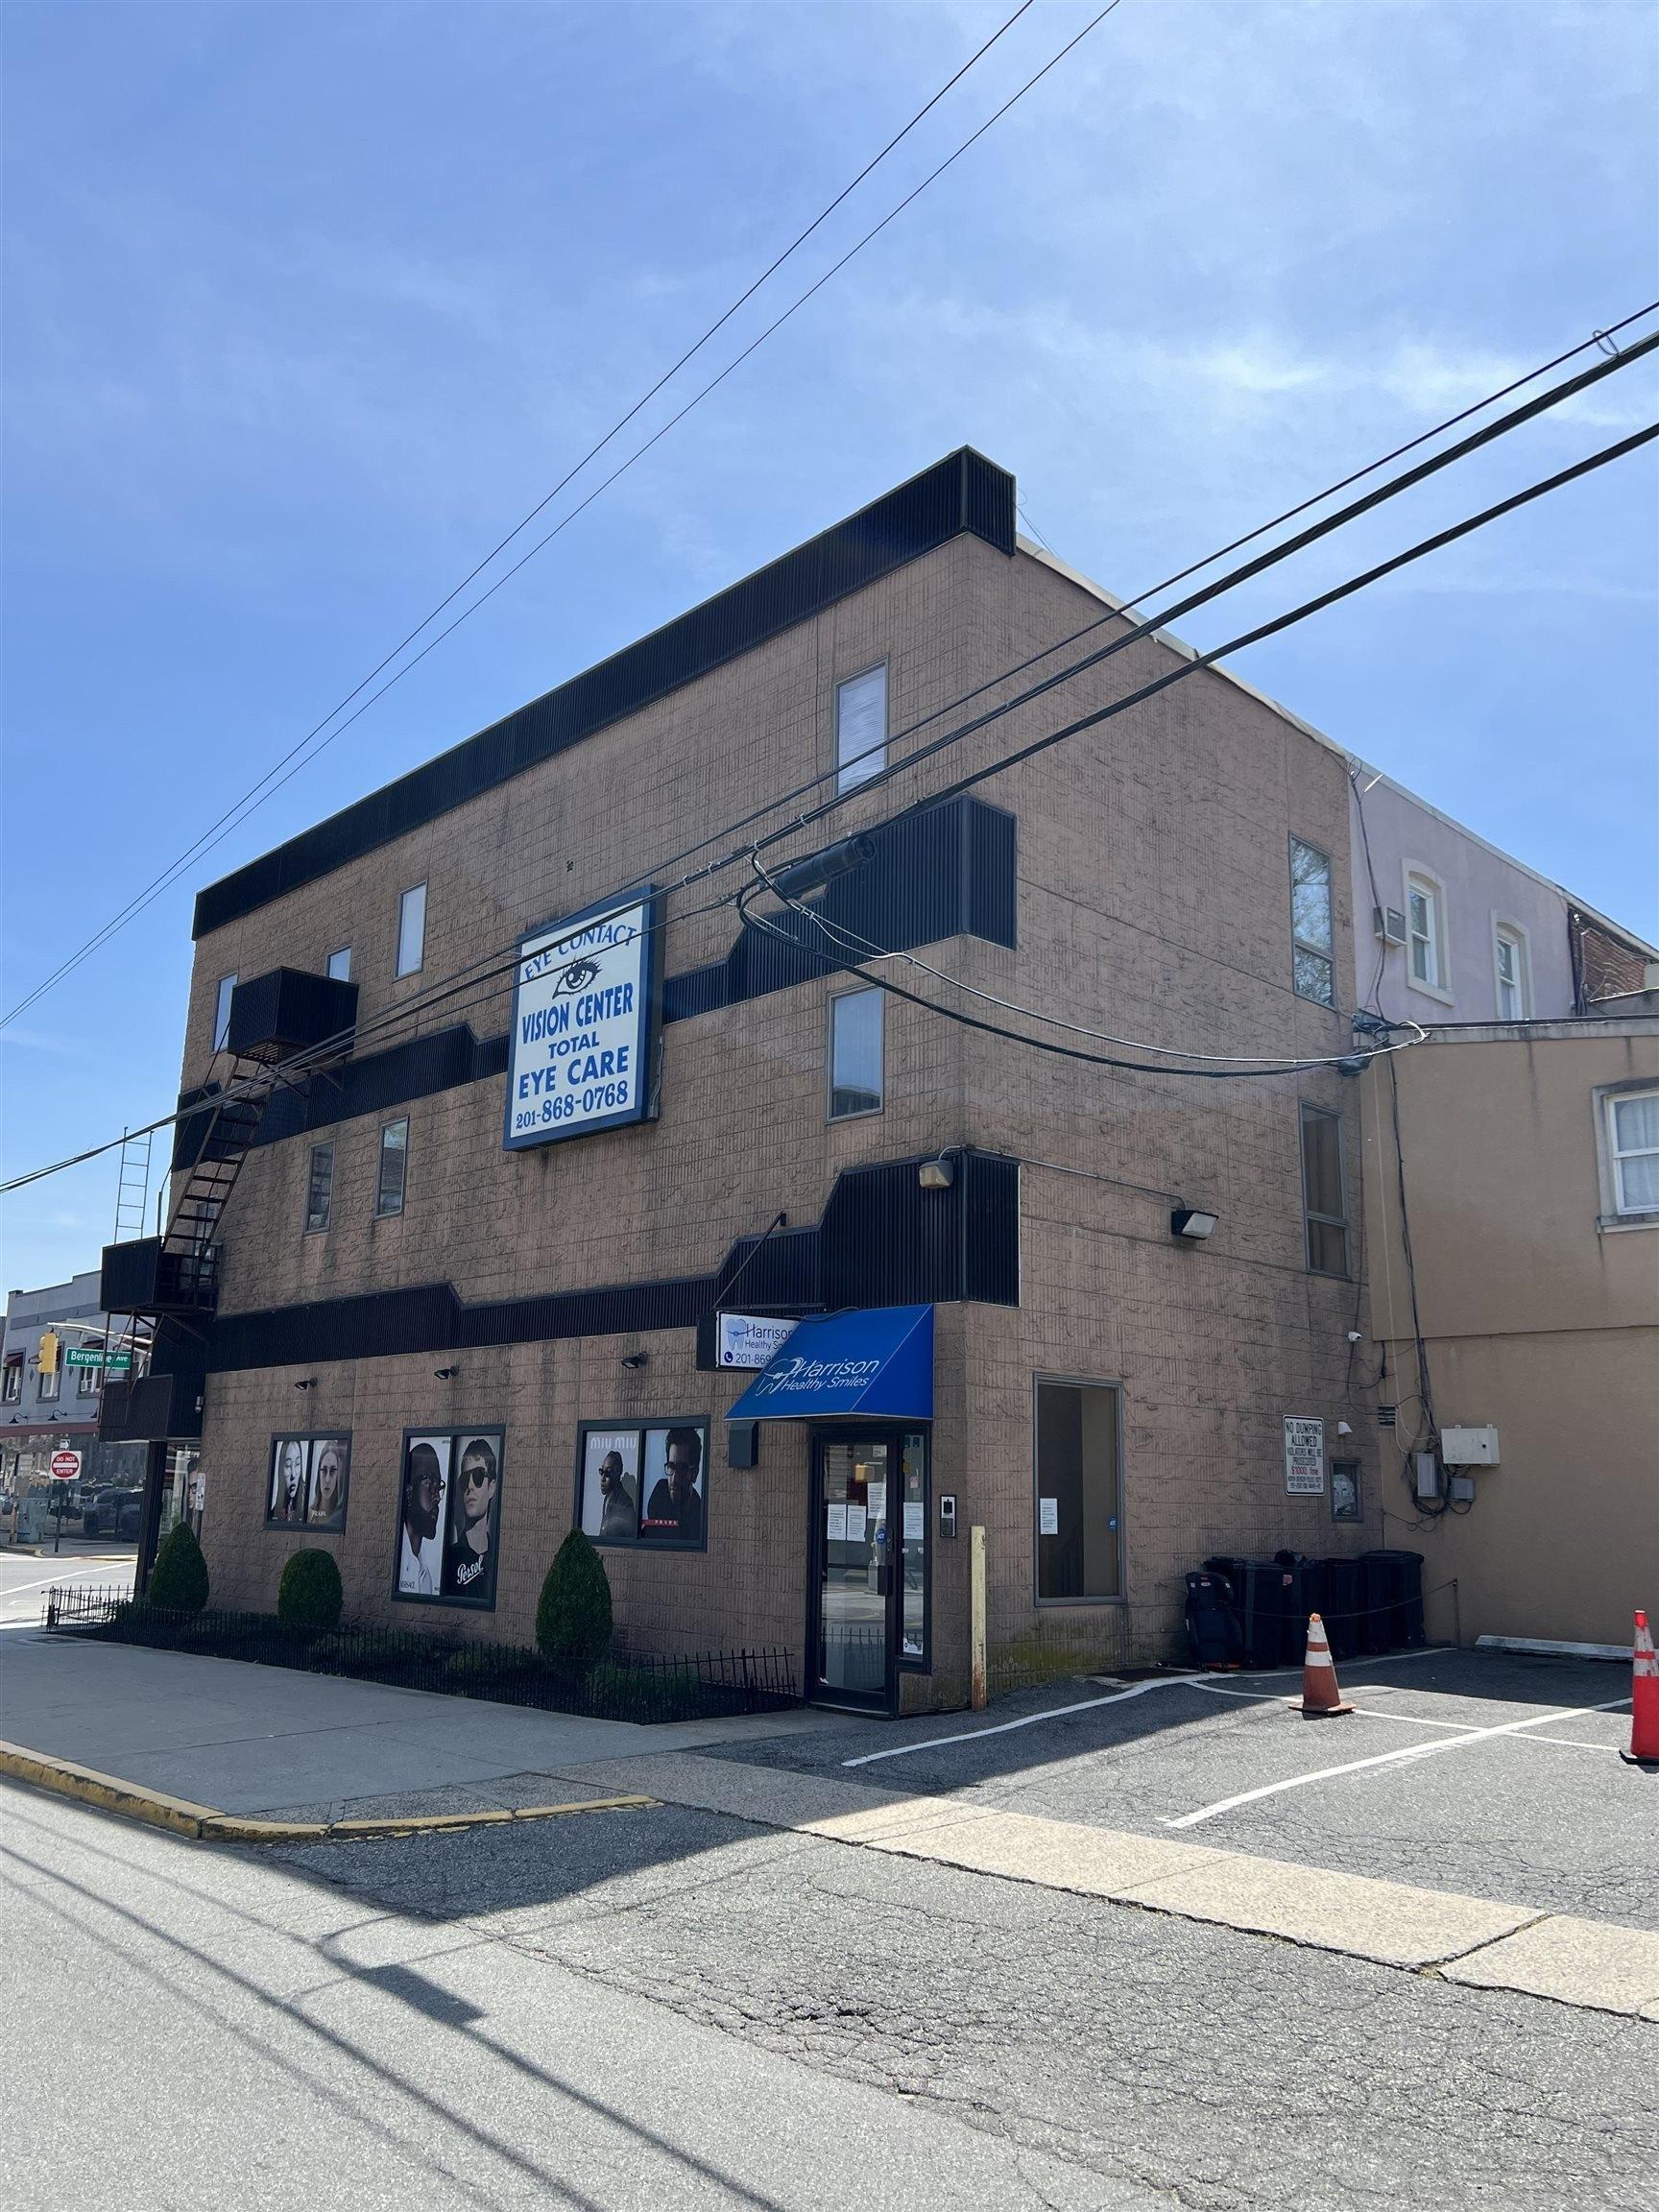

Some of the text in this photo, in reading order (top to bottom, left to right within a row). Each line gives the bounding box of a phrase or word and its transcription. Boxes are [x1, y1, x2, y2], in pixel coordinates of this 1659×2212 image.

[524, 925, 637, 979] EYE CONTACT
[521, 982, 634, 1045] VISION CENTER
[548, 1031, 600, 1059] TOTAL
[518, 1045, 630, 1100] EYE CARE
[516, 1080, 628, 1131] 201-868-0768
[745, 1340, 772, 1351] Healthy
[70, 1351, 112, 1364] Bergenlie
[793, 1358, 879, 1378] Harrison
[781, 1375, 870, 1391] Healthy Smiles
[1286, 1422, 1322, 1435] NO DUMPING
[1291, 1435, 1317, 1447] ALLOWED
